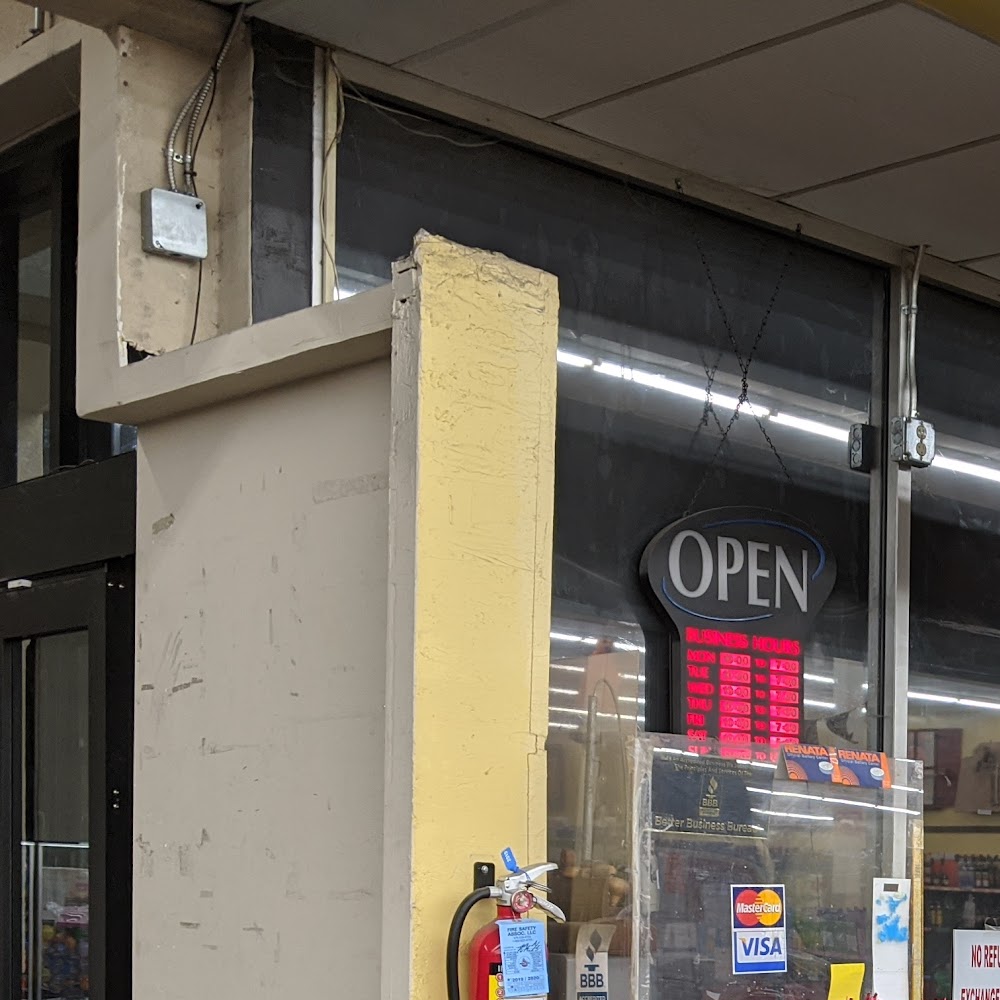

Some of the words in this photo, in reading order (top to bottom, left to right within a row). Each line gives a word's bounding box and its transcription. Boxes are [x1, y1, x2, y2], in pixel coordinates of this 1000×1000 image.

[668, 529, 808, 613] OPEN
[686, 627, 749, 649] BUSINESS
[752, 635, 800, 656] HOURS
[784, 743, 828, 756] RENATA
[838, 750, 880, 763] RENATA
[655, 816, 684, 828] Better
[686, 817, 725, 832] Business
[735, 902, 781, 915] MasterCard
[740, 936, 783, 957] VISA
[971, 945, 982, 968] NO
[580, 974, 604, 988] BBB
